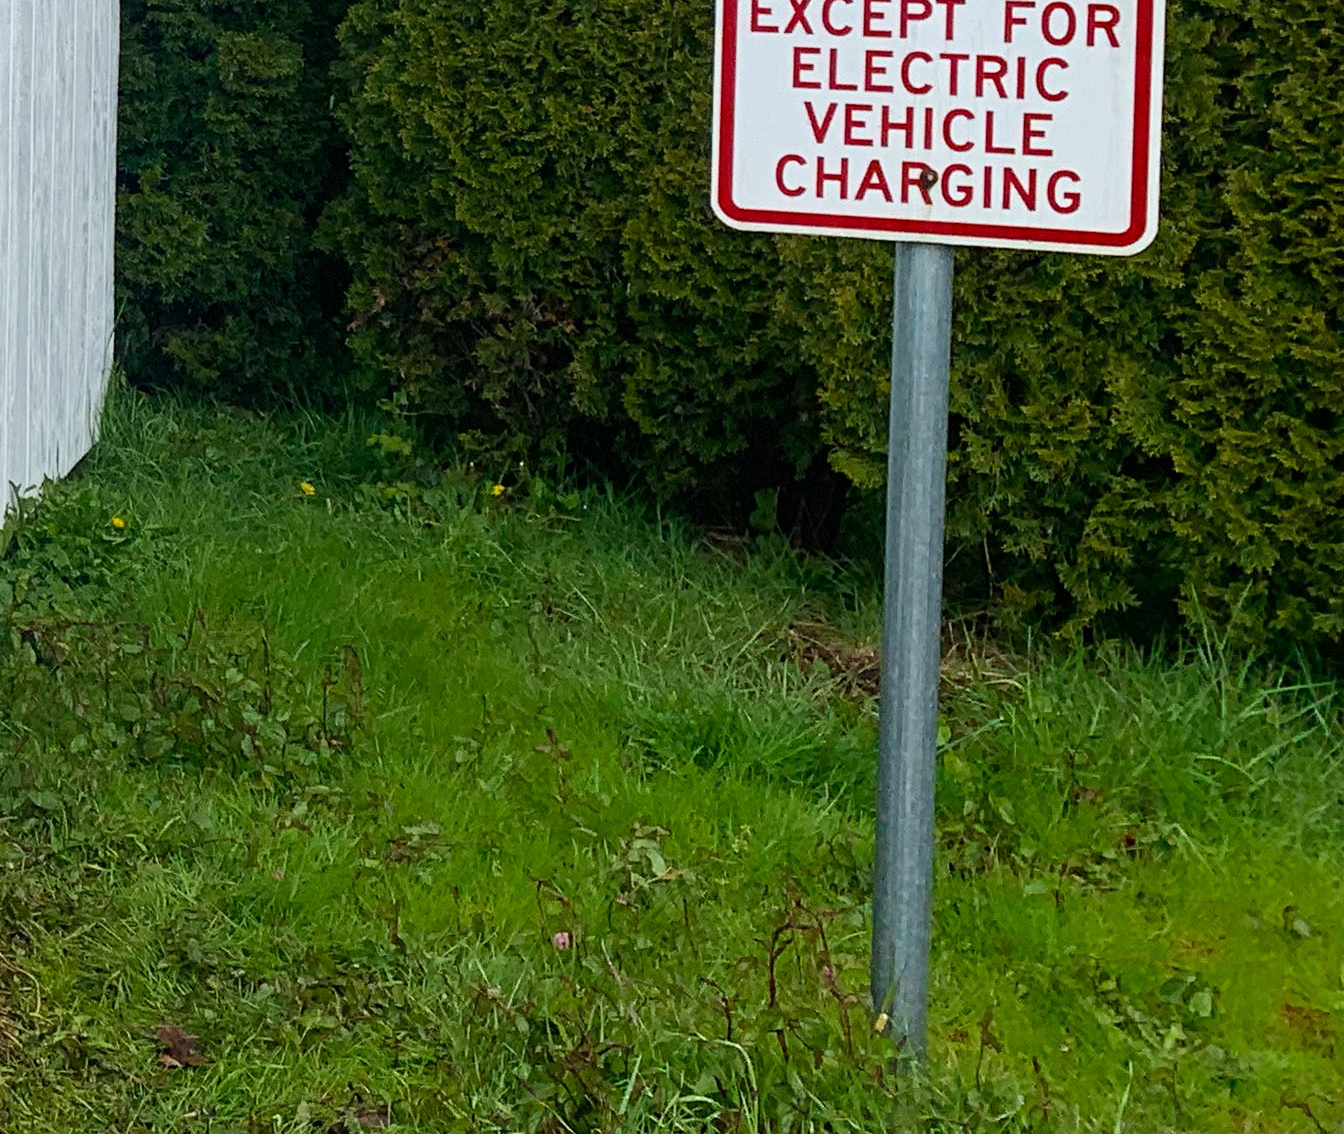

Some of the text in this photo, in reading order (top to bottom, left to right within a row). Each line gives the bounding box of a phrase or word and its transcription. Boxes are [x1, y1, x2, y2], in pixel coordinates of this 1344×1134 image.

[1003, 0, 1121, 48] FOR
[792, 46, 1070, 102] ELECTRIC
[804, 101, 1054, 157] VEHICLE
[775, 154, 1082, 214] CHARGING
